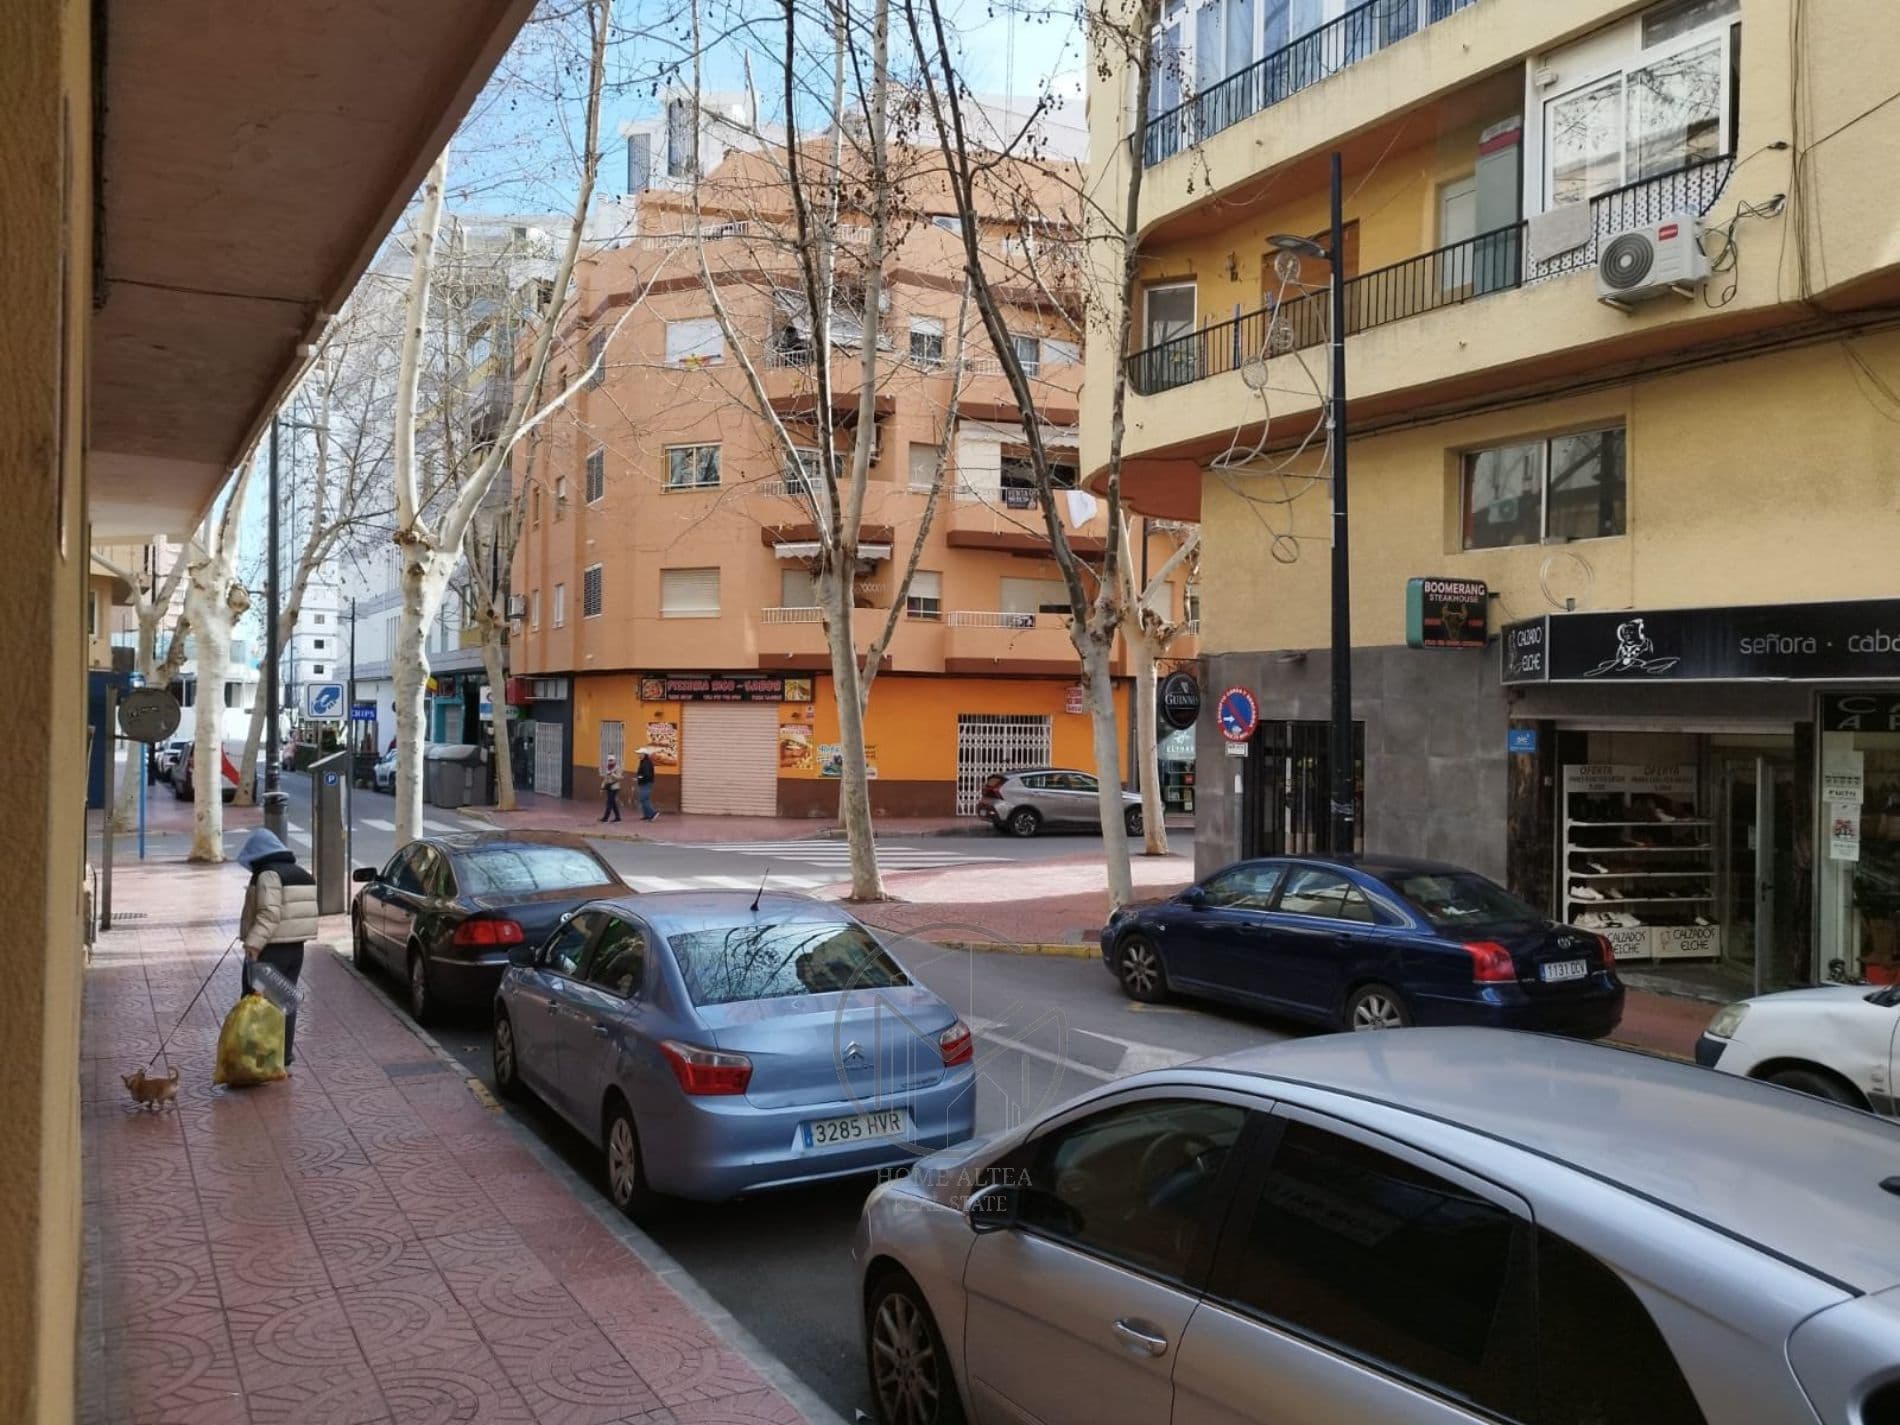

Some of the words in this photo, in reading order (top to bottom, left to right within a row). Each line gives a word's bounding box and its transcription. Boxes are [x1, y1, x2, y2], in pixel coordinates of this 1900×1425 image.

[1424, 581, 1485, 596] BOOMERANG
[1429, 593, 1479, 603] STEAKHOUSE
[1740, 633, 1817, 654] señora
[815, 1118, 862, 1144] 3285
[867, 1112, 901, 1136] HVR
